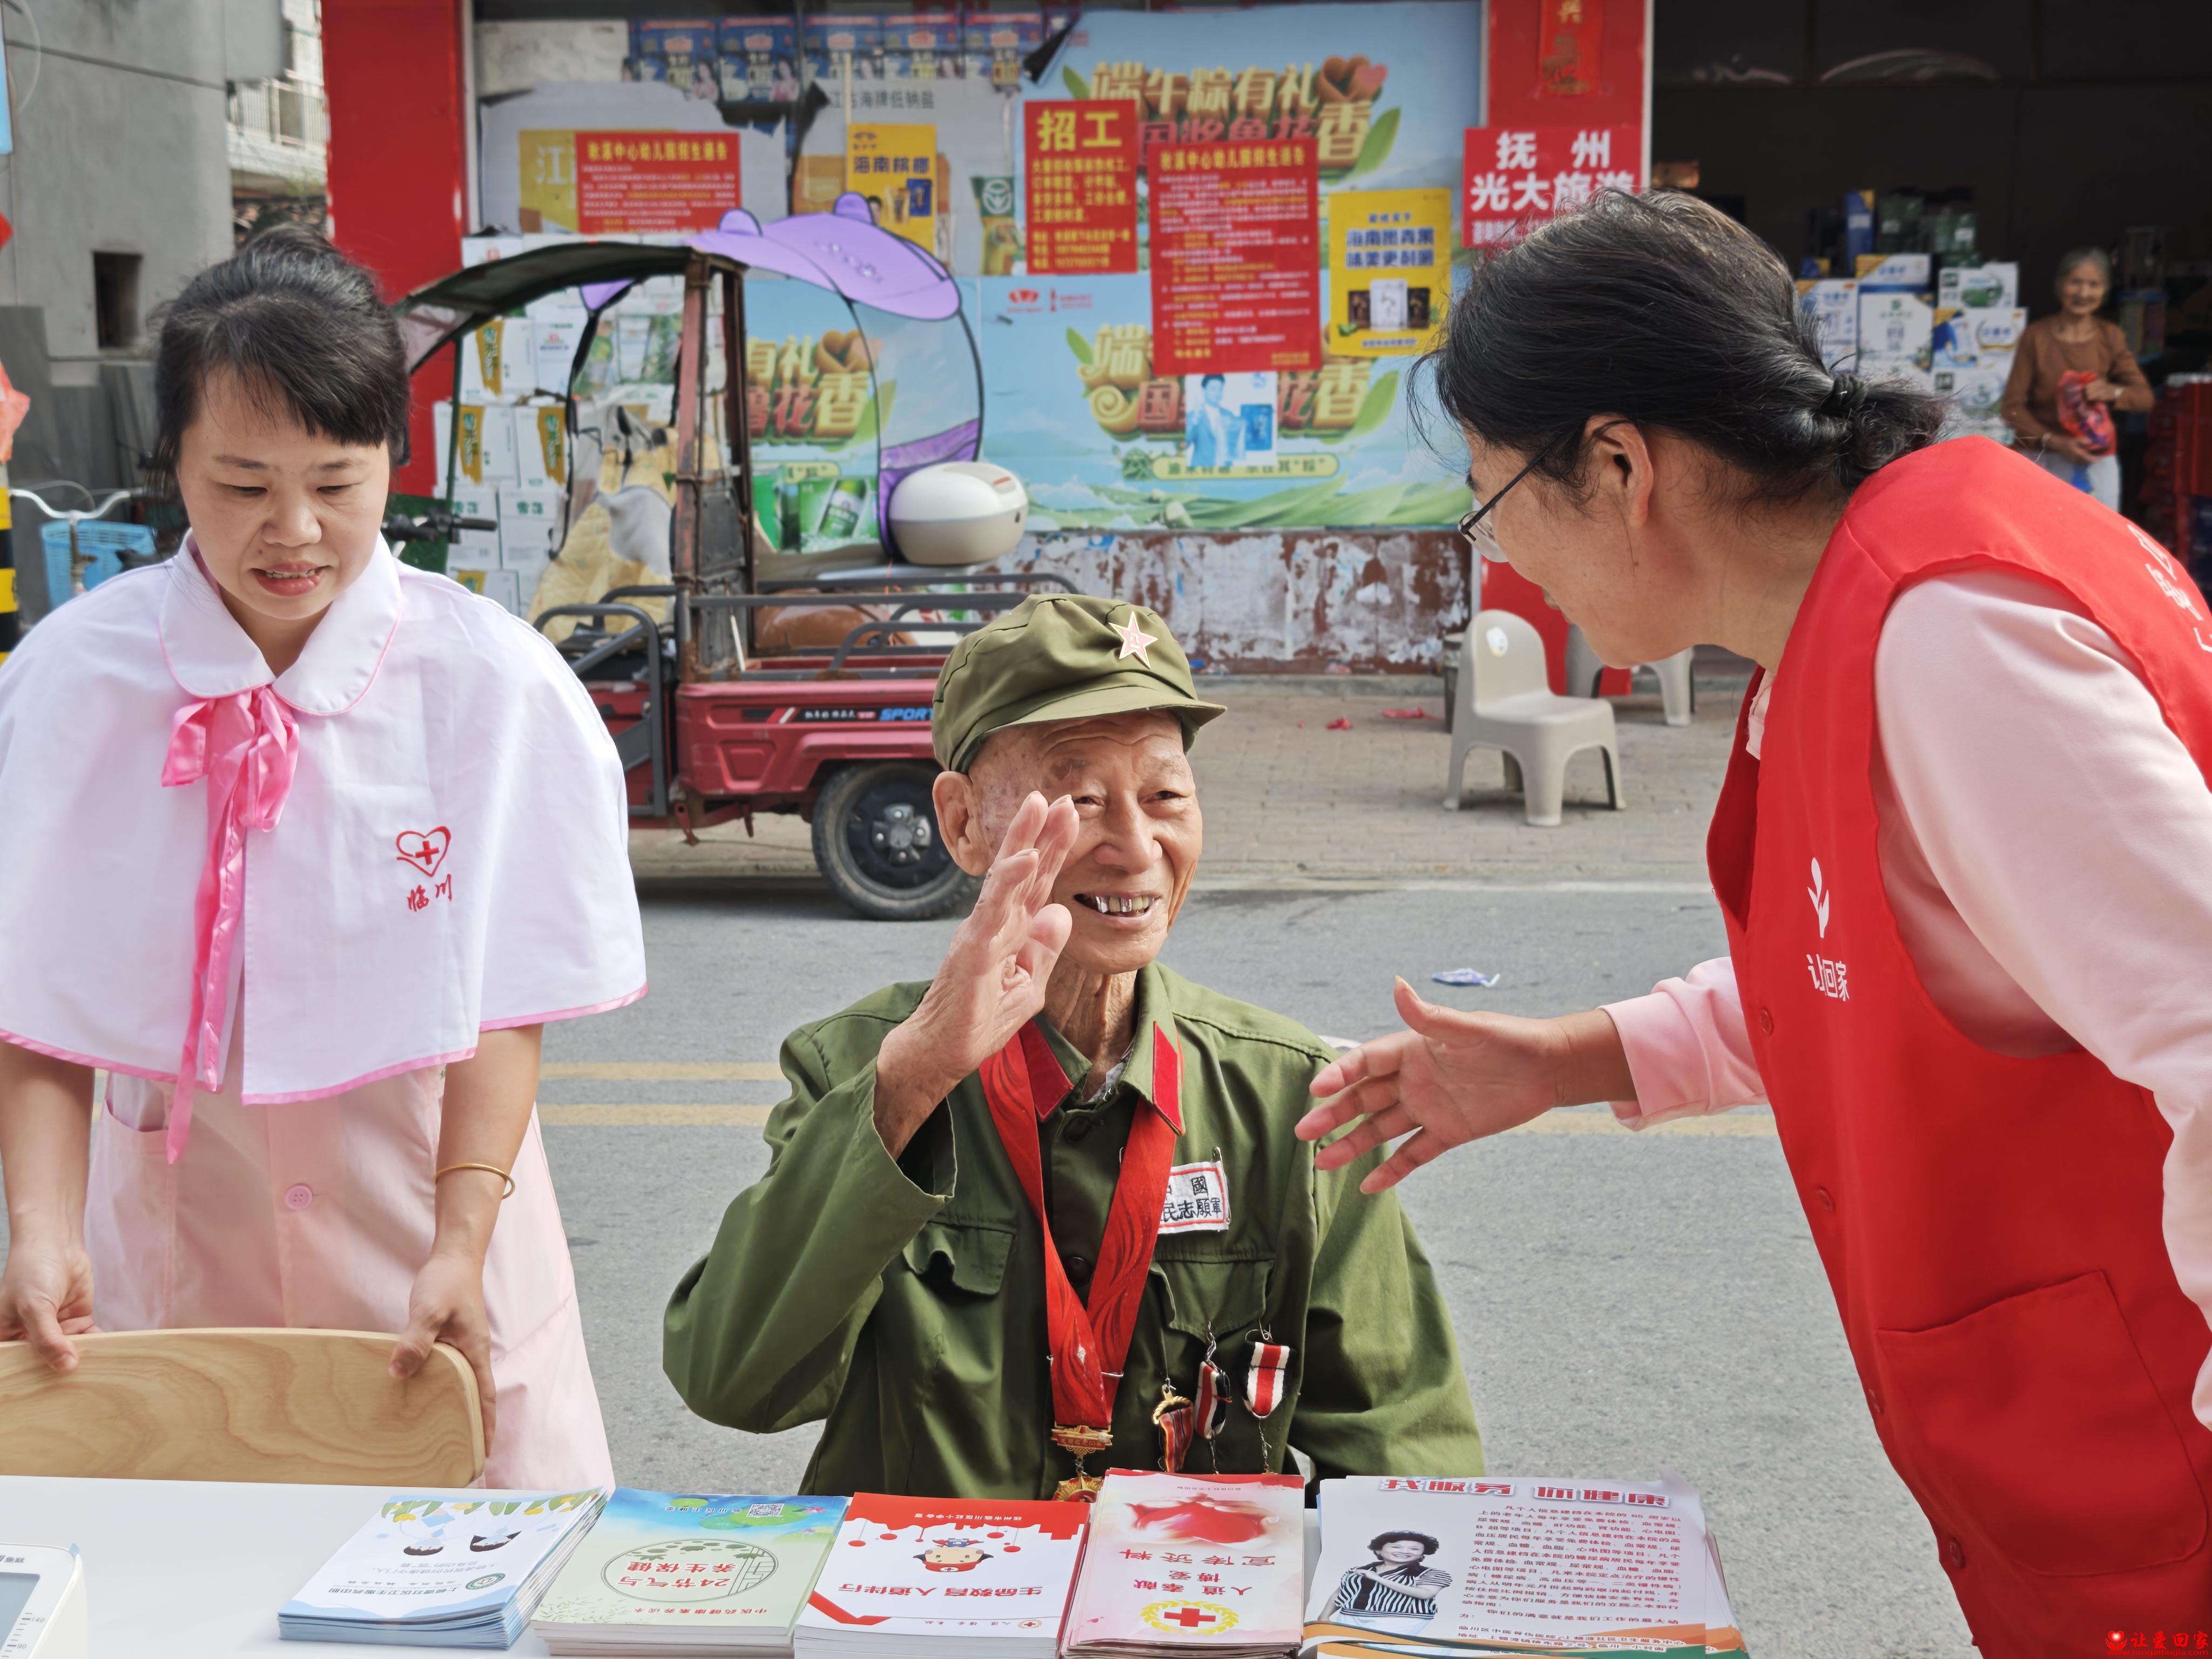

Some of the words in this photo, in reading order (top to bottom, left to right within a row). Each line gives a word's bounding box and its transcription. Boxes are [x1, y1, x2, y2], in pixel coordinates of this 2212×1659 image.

[1037, 109, 1122, 151] 招工
[1496, 130, 1610, 170] 抚州
[407, 874, 452, 912] 临川
[1161, 1197, 1222, 1222] 民志願軍
[1387, 1479, 1511, 1495] 我服务
[1538, 1486, 1667, 1506] 你健康
[1120, 1549, 1276, 1566] 宣传资料
[626, 1561, 737, 1573] 养生保健
[618, 1577, 731, 1588] 24节气与
[1169, 1570, 1219, 1582] 博爱
[838, 1583, 938, 1596] 人道伴行
[944, 1586, 1043, 1597] 生命教育
[1134, 1580, 1184, 1593] 奉献
[1202, 1586, 1253, 1596] 人道
